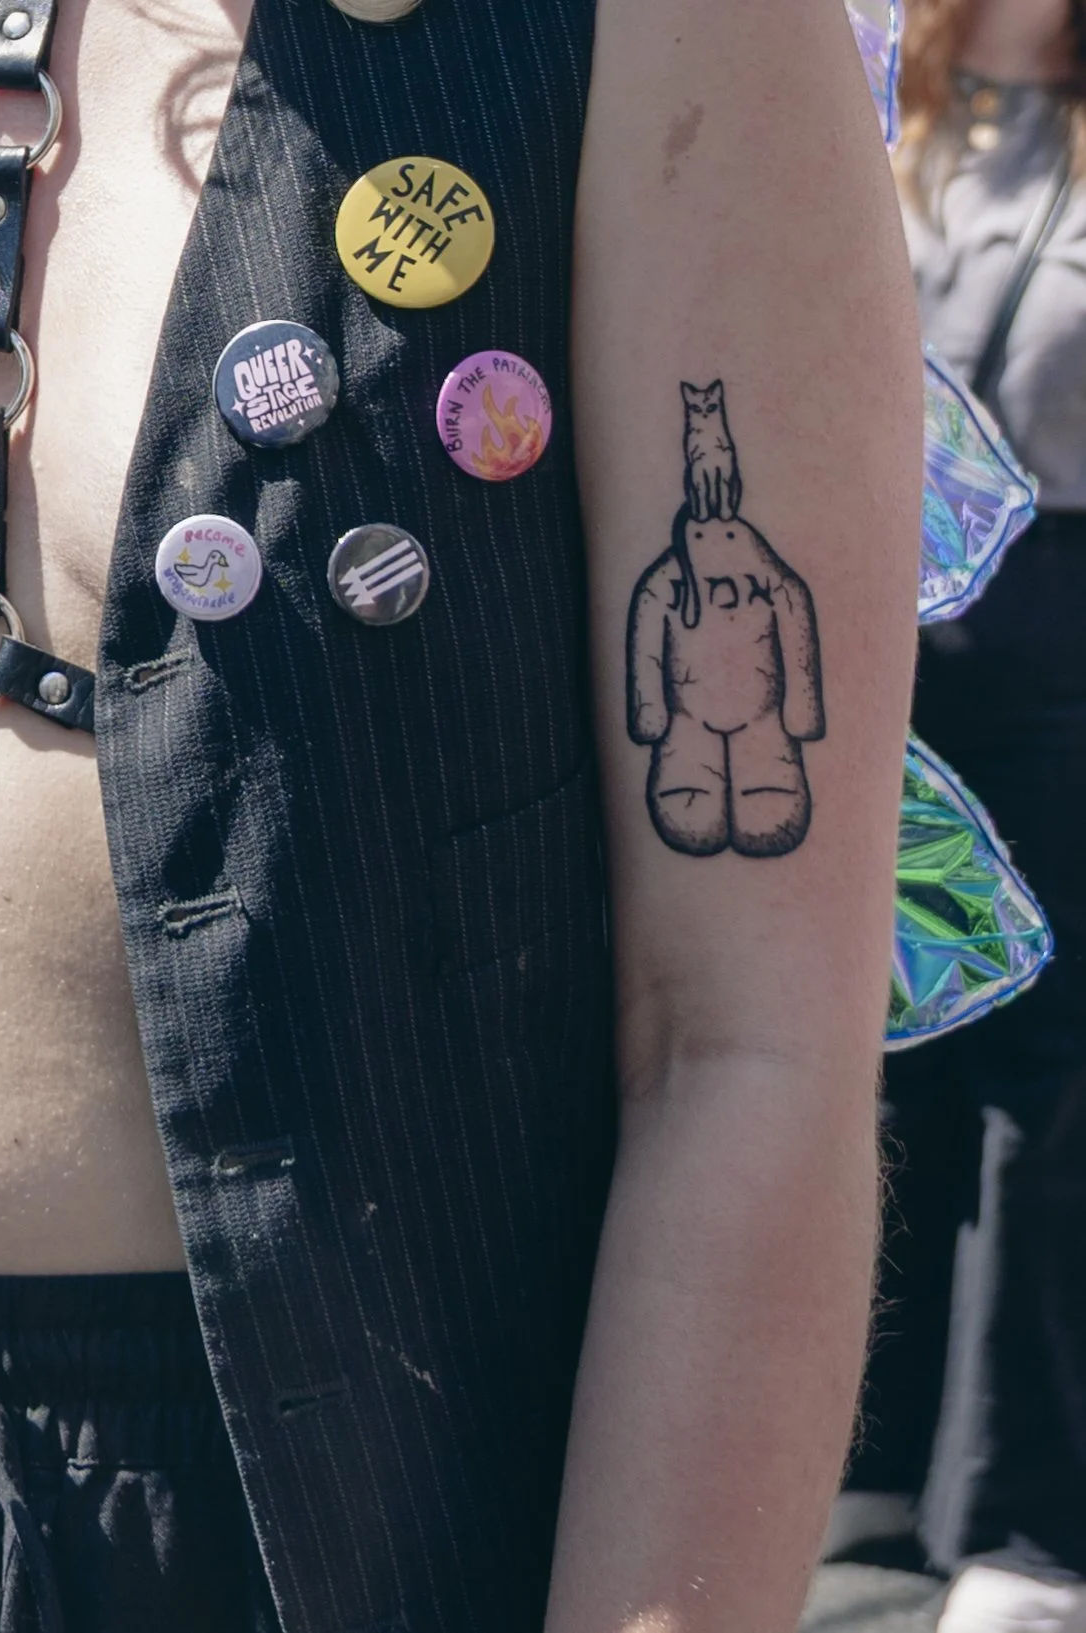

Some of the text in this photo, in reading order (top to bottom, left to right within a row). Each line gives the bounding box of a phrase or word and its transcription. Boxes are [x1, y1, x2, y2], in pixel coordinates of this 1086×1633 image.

[390, 163, 485, 232] SAFE
[367, 195, 453, 264] WITH
[352, 235, 417, 293] ME
[233, 339, 311, 401] QUEER
[246, 374, 319, 419] STAGE
[249, 394, 323, 434] REVOLUTION
[445, 399, 464, 453] BURN
[457, 366, 487, 394] THE
